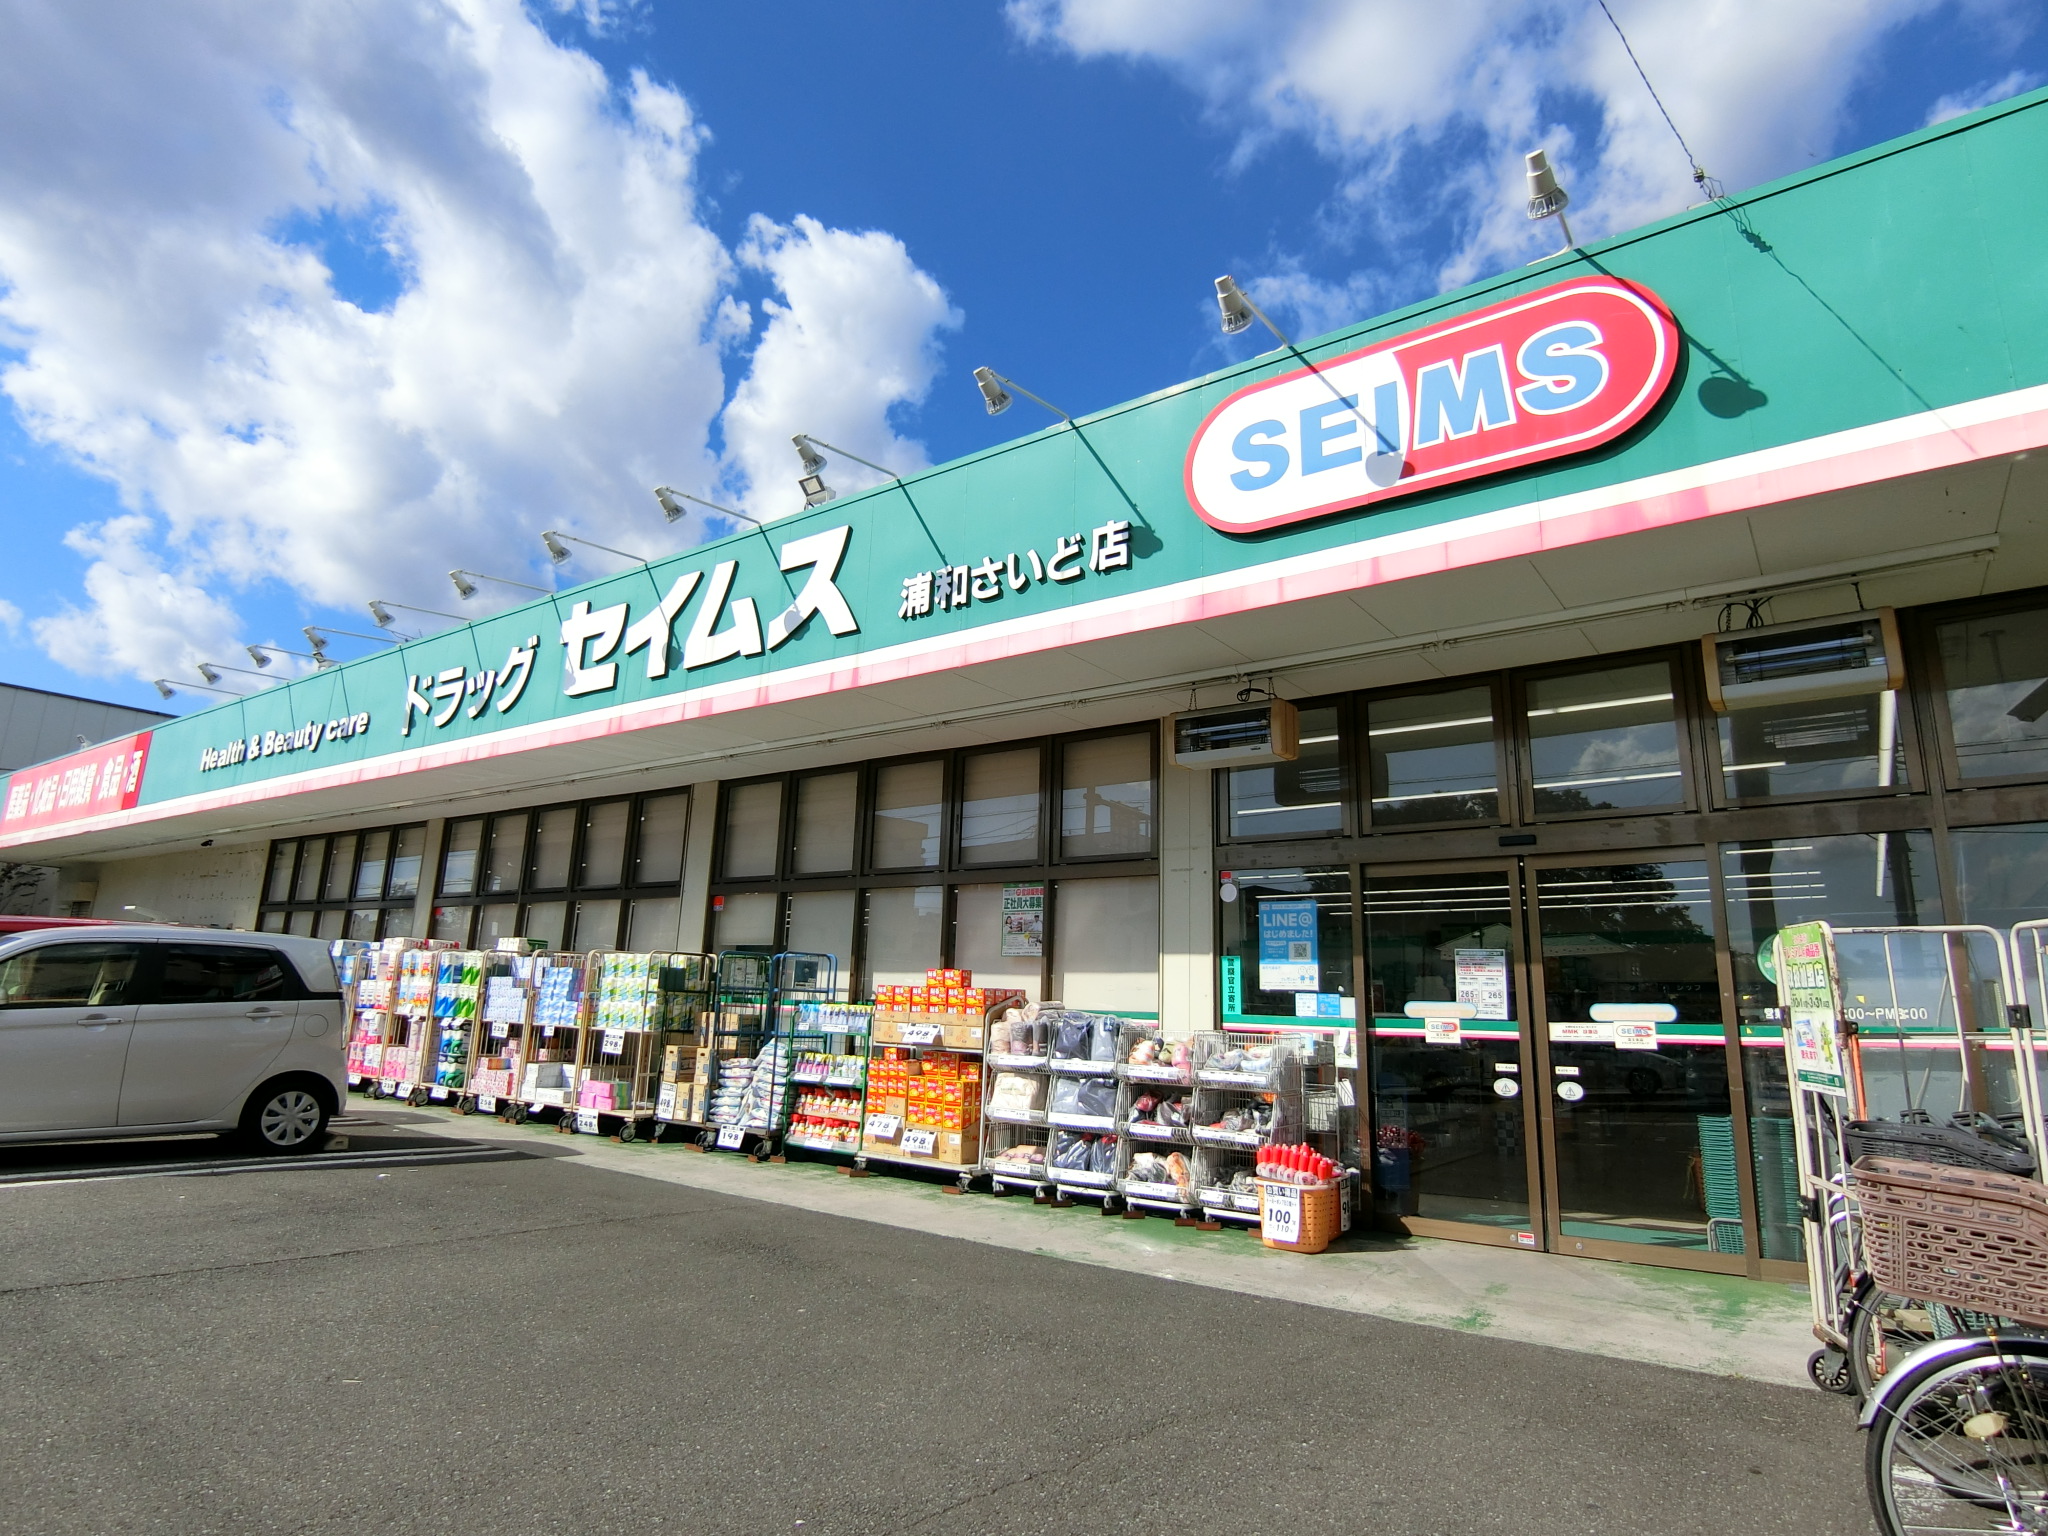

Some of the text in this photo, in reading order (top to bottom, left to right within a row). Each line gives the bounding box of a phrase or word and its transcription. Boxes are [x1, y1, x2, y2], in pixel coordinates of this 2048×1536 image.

[1229, 321, 1607, 493] SEIMS
[898, 520, 1129, 618] 浦和さいど店
[401, 524, 859, 736] ドラッグ セイムス
[200, 712, 369, 771] Health & Beauty care
[1263, 912, 1313, 927] LINE@
[1227, 957, 1236, 1013] 警察官立寄所
[1621, 1027, 1649, 1035] SEIMS
[603, 1039, 619, 1048] 298
[578, 1119, 594, 1128] 248
[868, 1120, 890, 1129] 478
[722, 1132, 739, 1141] 198
[903, 1135, 926, 1146] 498
[1268, 1208, 1291, 1224] 100
